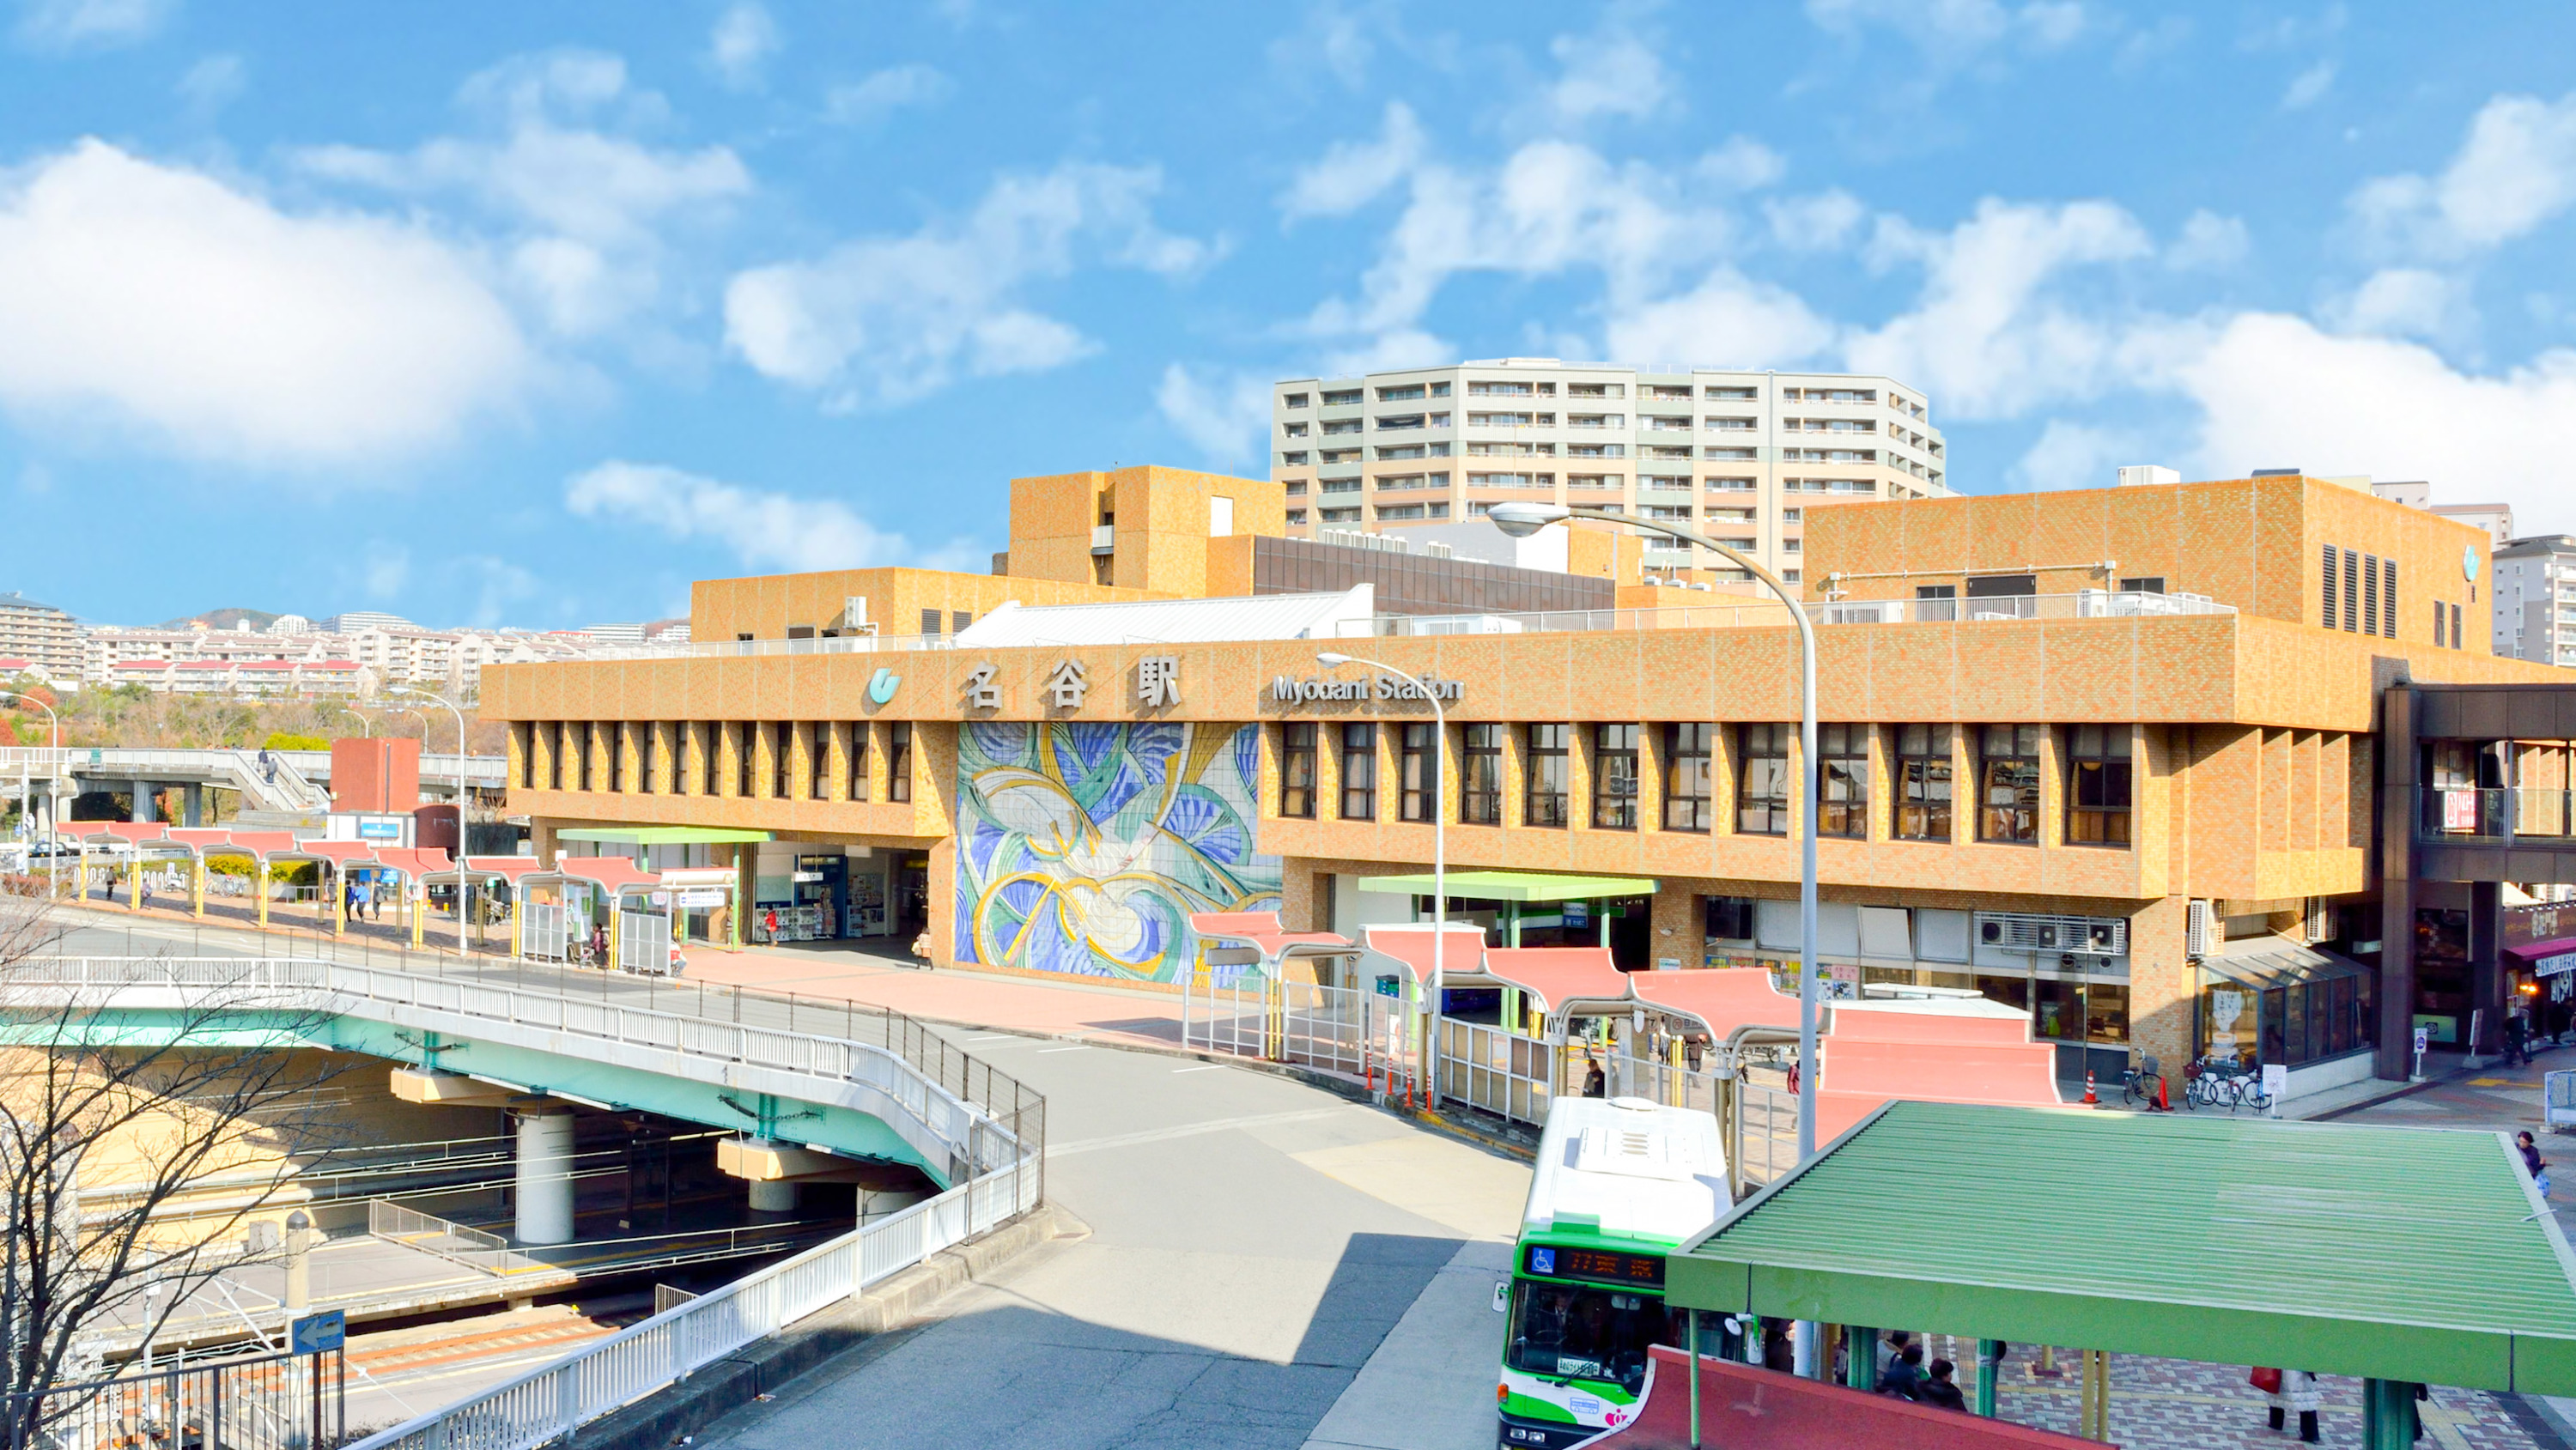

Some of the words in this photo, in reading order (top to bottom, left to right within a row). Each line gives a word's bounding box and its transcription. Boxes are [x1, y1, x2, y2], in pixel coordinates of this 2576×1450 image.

[967, 656, 1182, 708] 名谷駅
[1273, 674, 1370, 706] Myōdani
[1376, 674, 1465, 700] Station
